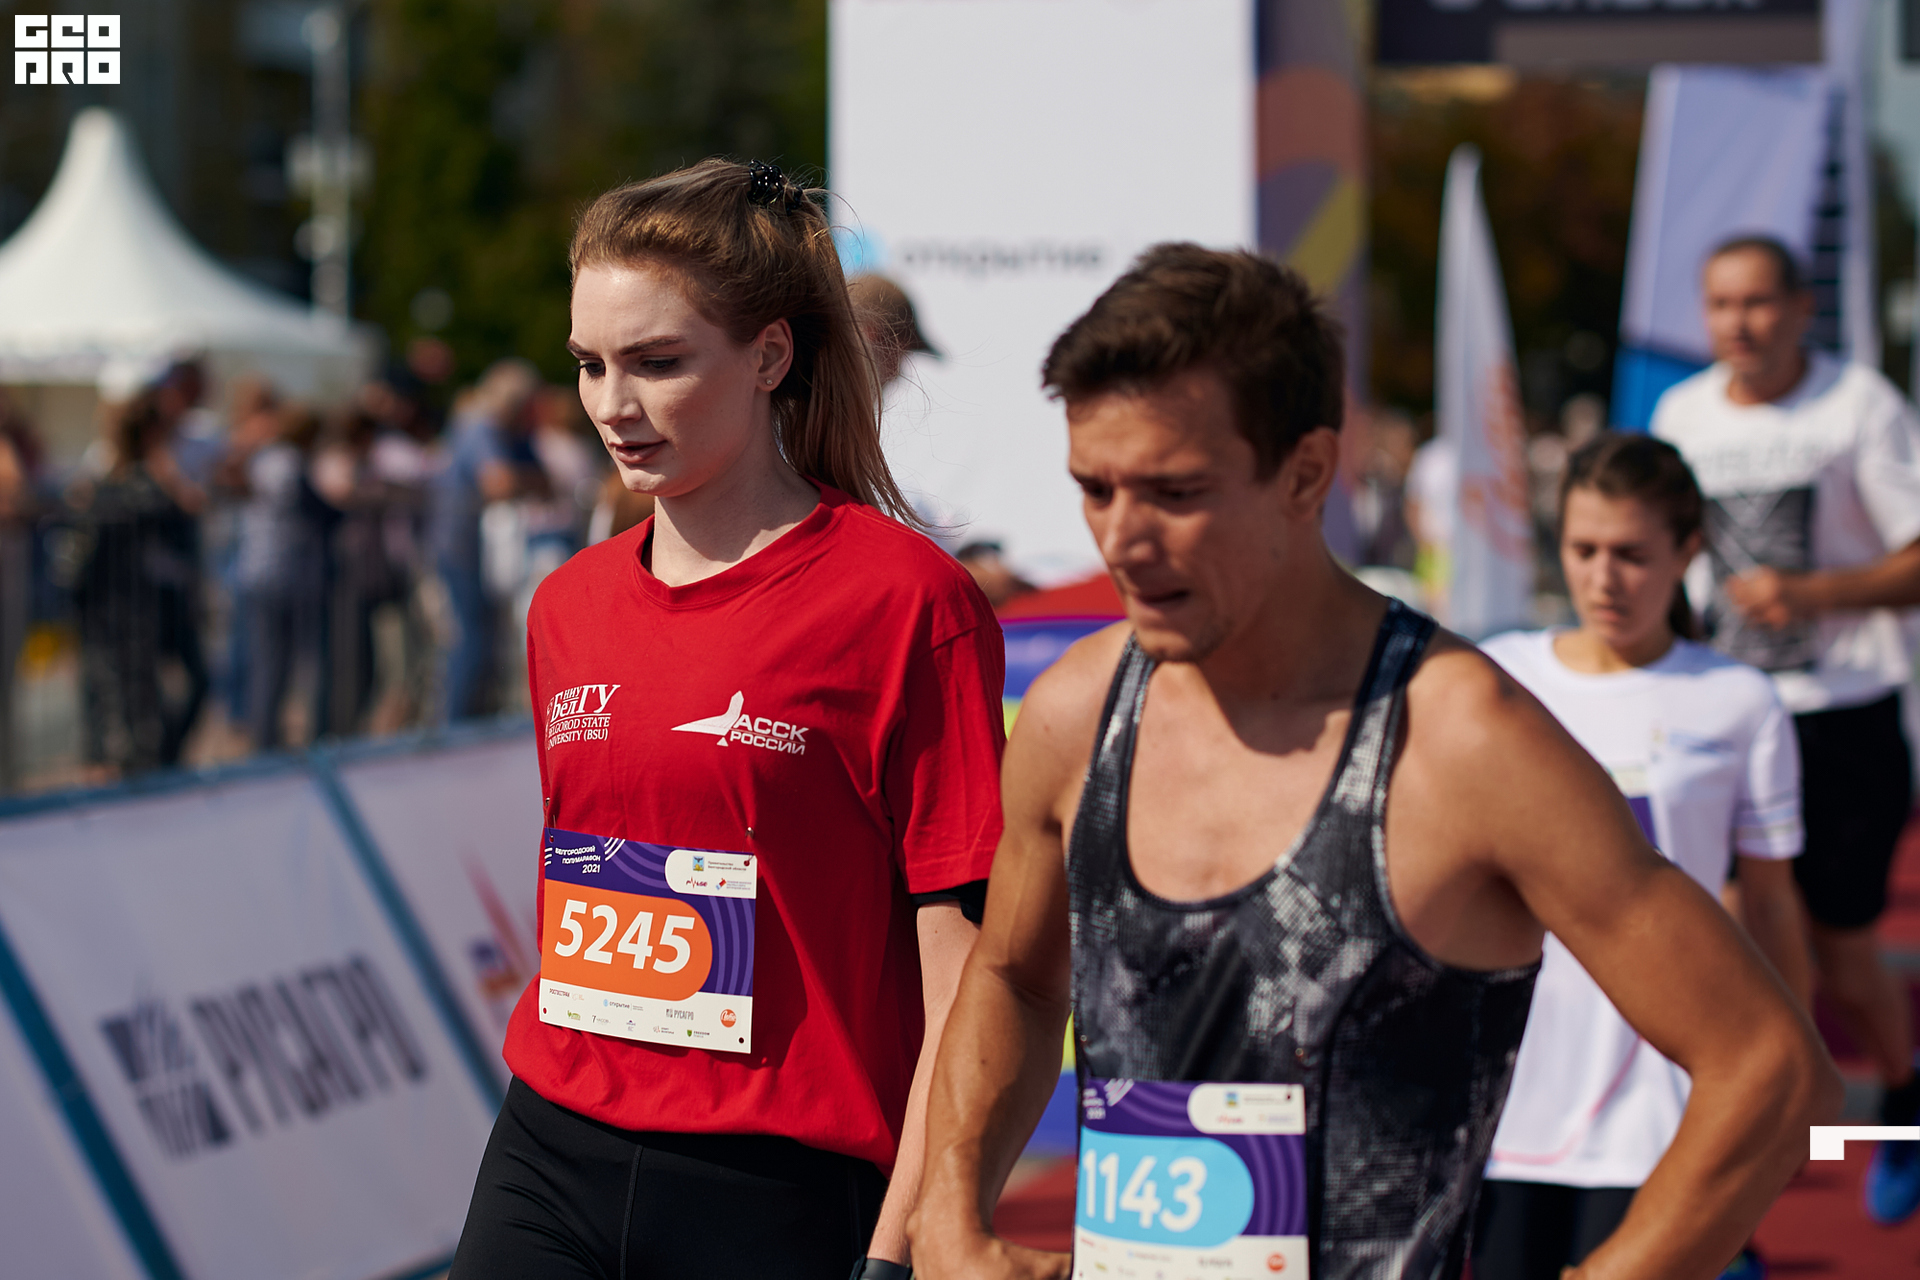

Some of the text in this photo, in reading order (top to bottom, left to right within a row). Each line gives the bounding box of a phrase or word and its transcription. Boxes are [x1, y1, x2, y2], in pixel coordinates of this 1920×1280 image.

[581, 716, 611, 728] STATE
[733, 714, 809, 742] АССК
[583, 728, 608, 741] (BSU)
[730, 730, 806, 755] РОССИИ
[555, 845, 596, 856] БЕЛГОРОДСКИЙ
[562, 854, 601, 865] ПОЛУМАРАФОН
[582, 863, 601, 874] 2021
[554, 899, 695, 974] 5245
[1082, 1149, 1208, 1233] 1143
